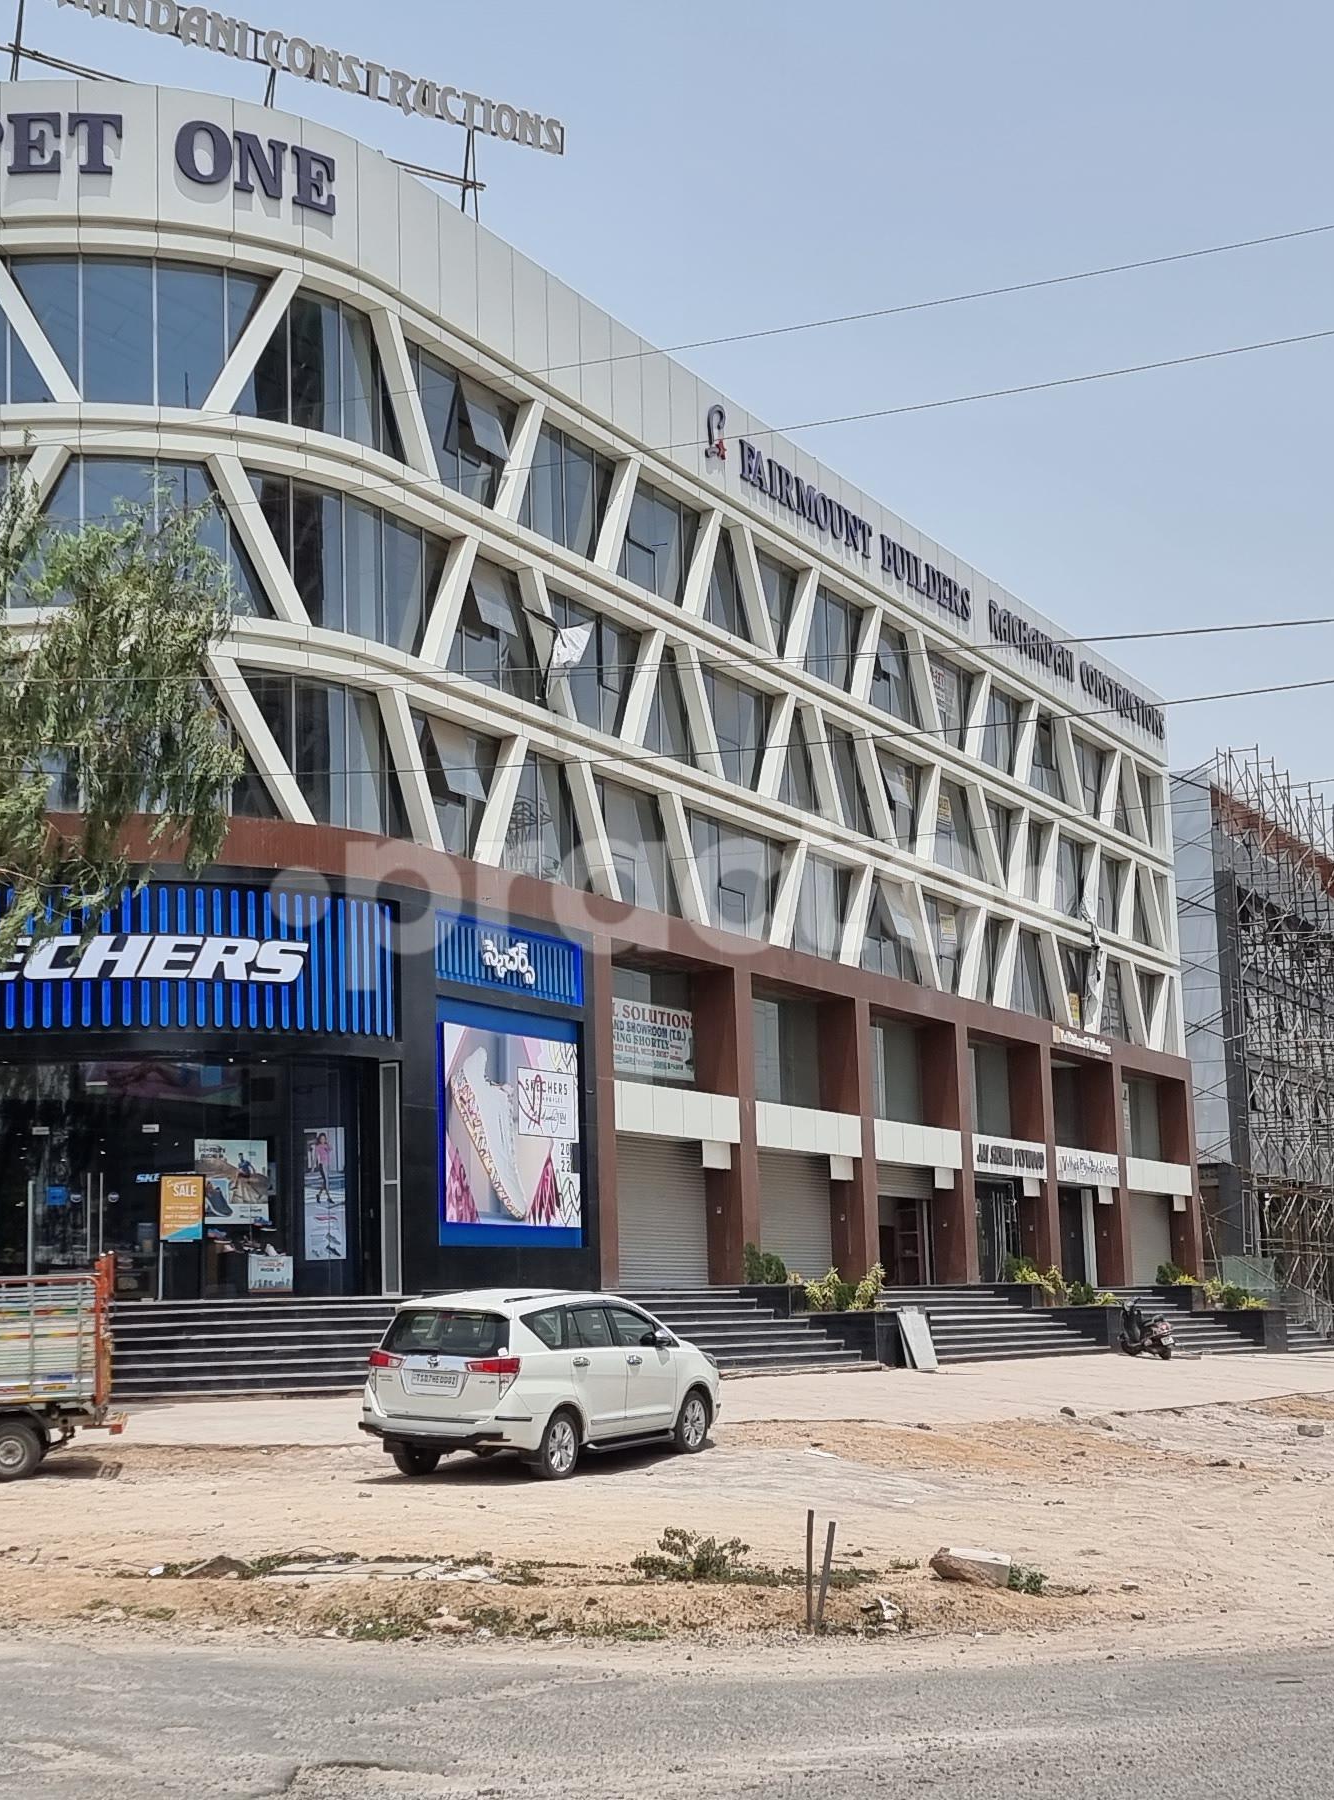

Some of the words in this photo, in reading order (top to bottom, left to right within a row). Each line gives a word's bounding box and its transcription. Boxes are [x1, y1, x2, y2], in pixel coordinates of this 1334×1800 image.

[57, 0, 249, 60] NDANI
[263, 30, 562, 154] CONSTRUCTIONS
[174, 119, 336, 216] ONE
[739, 438, 873, 560] FAIRMOUNT
[880, 533, 972, 622] BUILDERS
[1080, 660, 1165, 740] CONSTRUCTIONS
[622, 1004, 693, 1030] SOLUTION
[627, 1021, 668, 1039] SHOWROOM
[634, 1034, 669, 1050] SHORTLY
[525, 1078, 568, 1096] SKECHERS
[172, 1184, 197, 1197] SALE
